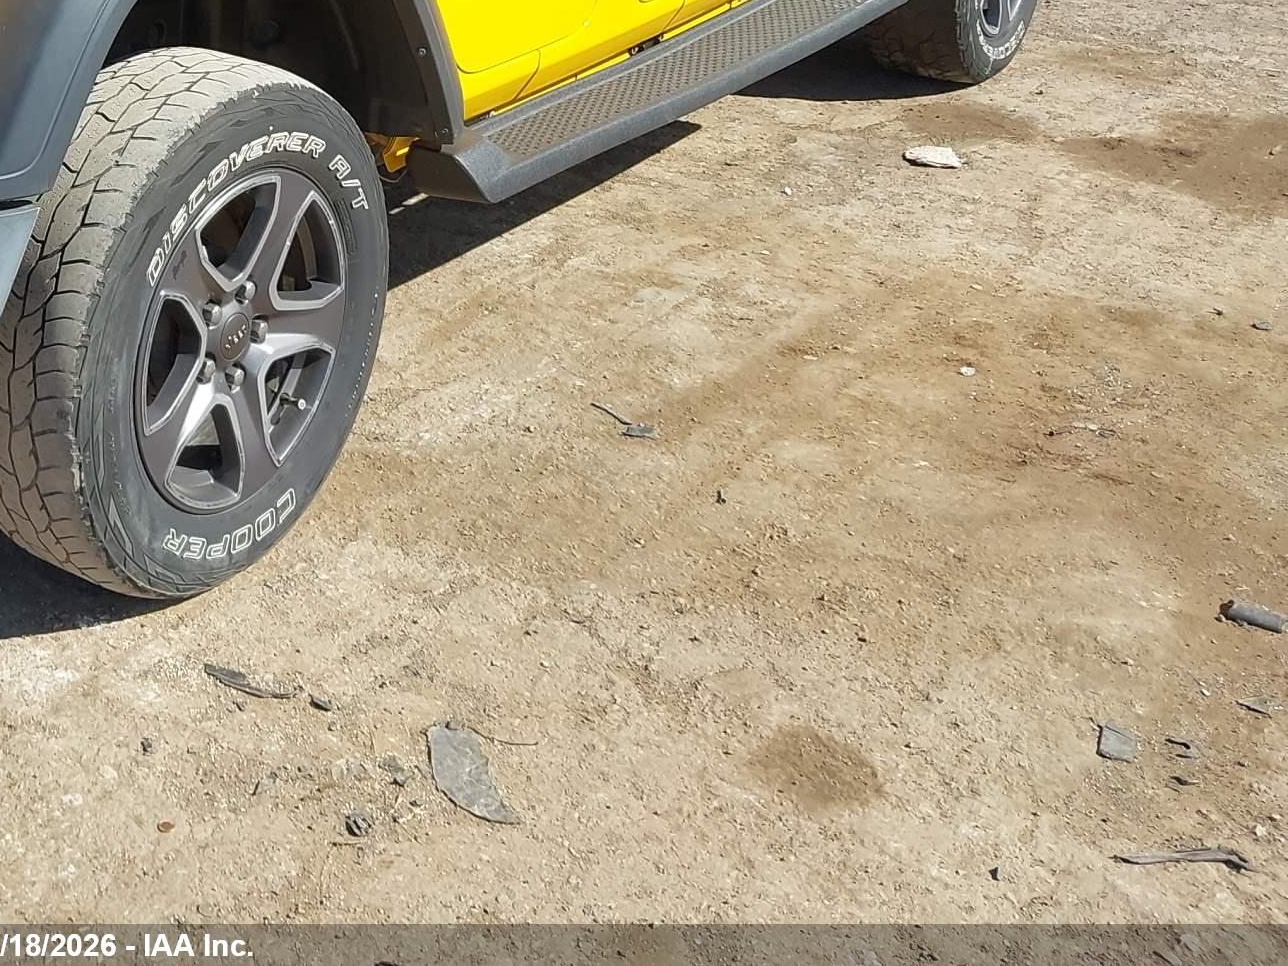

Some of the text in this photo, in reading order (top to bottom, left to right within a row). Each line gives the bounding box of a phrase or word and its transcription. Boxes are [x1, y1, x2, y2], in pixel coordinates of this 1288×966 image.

[145, 131, 327, 287] DISCOVERER
[328, 153, 369, 211] A/T
[162, 487, 297, 560] COOPER
